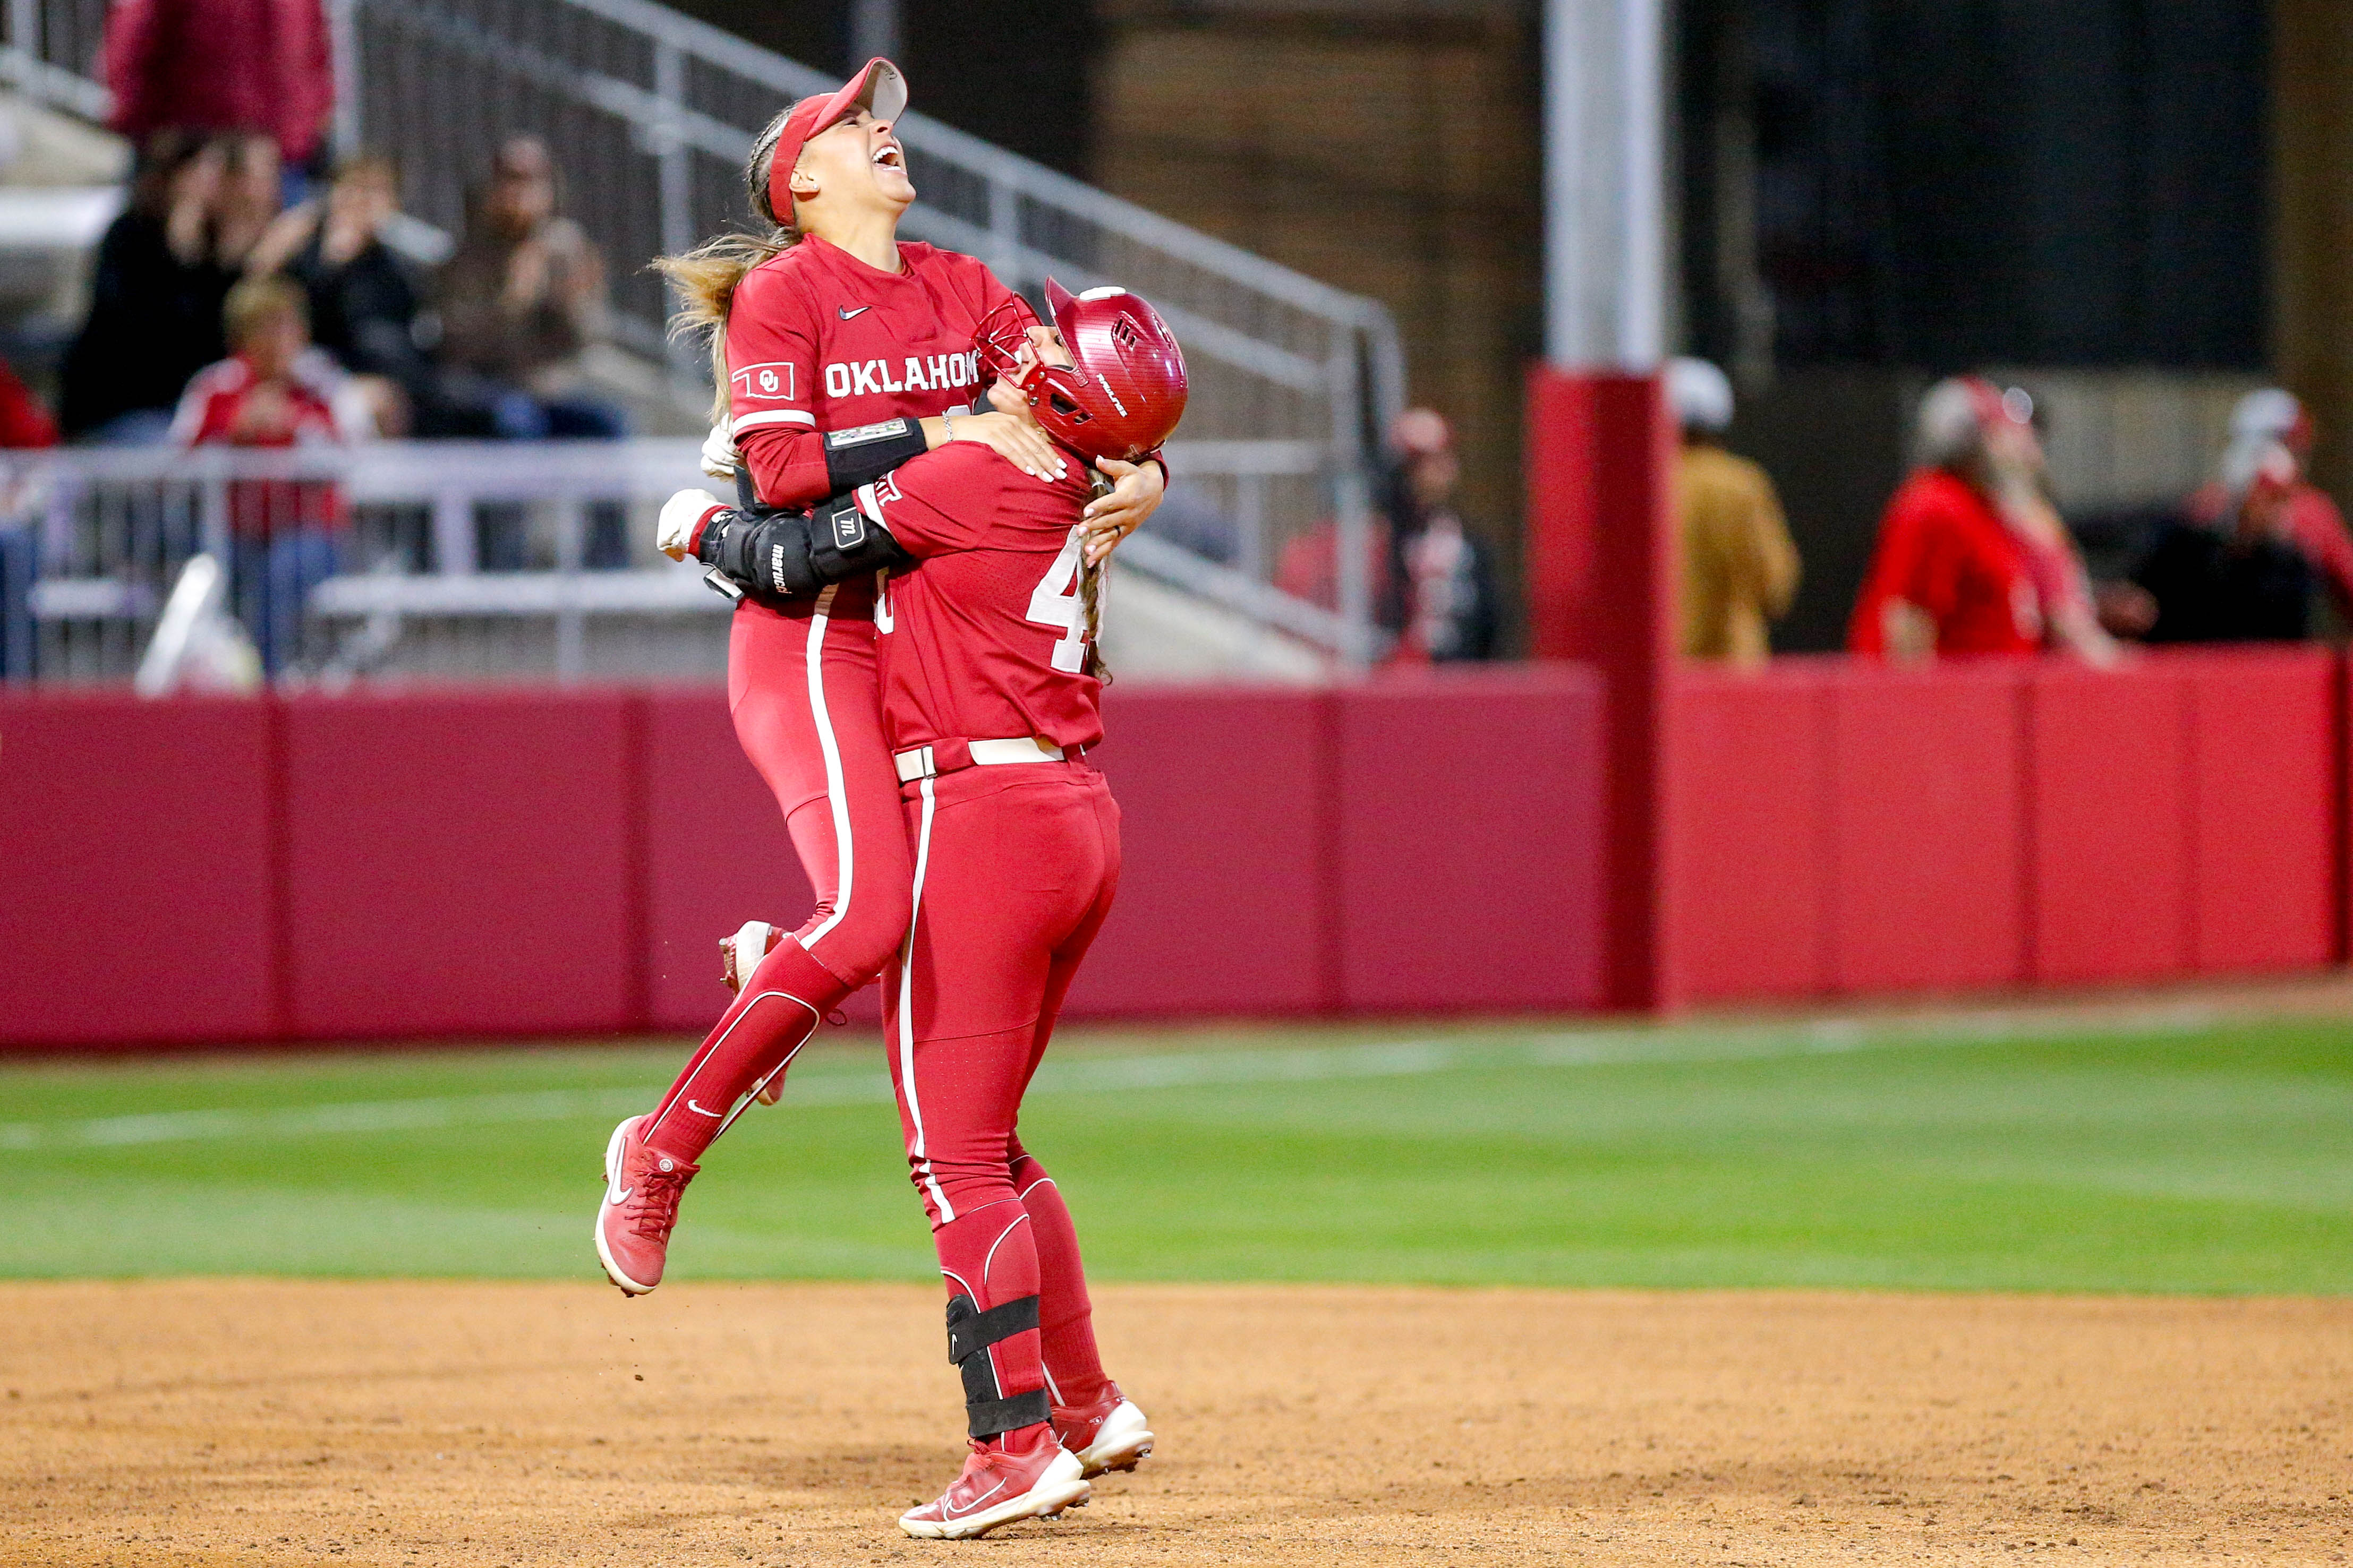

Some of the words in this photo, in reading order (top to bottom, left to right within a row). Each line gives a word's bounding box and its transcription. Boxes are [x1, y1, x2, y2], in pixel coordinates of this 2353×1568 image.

[759, 369, 779, 392] OU
[1096, 373, 1128, 418] RAWLINGS
[771, 543, 792, 594] marucci
